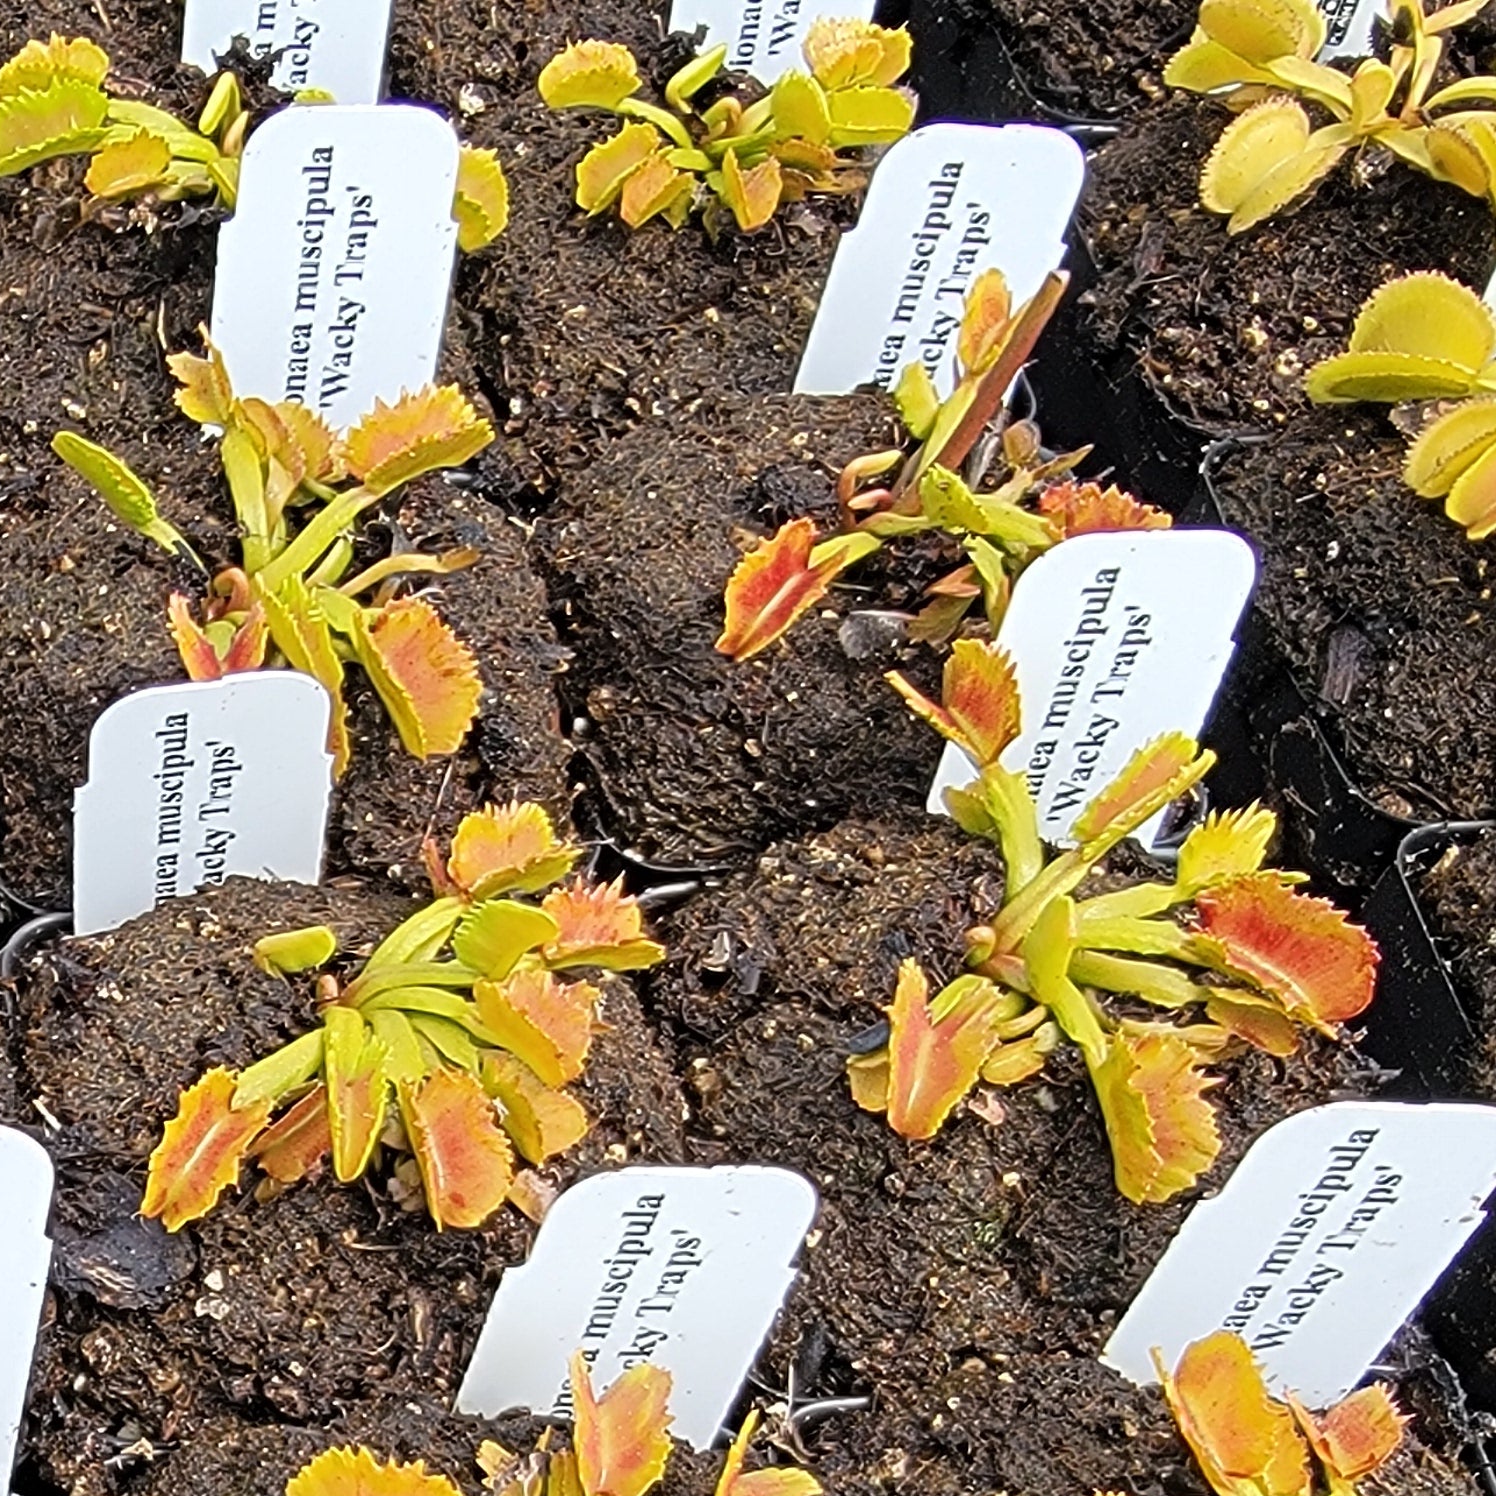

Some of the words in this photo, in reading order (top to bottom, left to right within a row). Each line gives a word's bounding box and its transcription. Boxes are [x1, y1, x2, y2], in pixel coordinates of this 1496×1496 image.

[294, 145, 335, 312] muscipula
[333, 186, 378, 288] Traps'
[892, 161, 964, 324] muscipula
[934, 202, 992, 301] Traps'
[285, 323, 313, 405] onaea
[320, 297, 366, 408] 'Wacky
[1042, 567, 1122, 730] muscipula
[1046, 713, 1119, 822] 'Wacky
[1090, 605, 1152, 705] Traps'
[153, 712, 195, 847] muscipula
[199, 741, 243, 821] Traps'
[582, 1193, 666, 1340] muscipula
[1250, 1263, 1344, 1352] Wacky
[1317, 1165, 1404, 1253] Traps'
[1257, 1128, 1381, 1275] muscipula
[635, 1229, 703, 1319] Traps'
